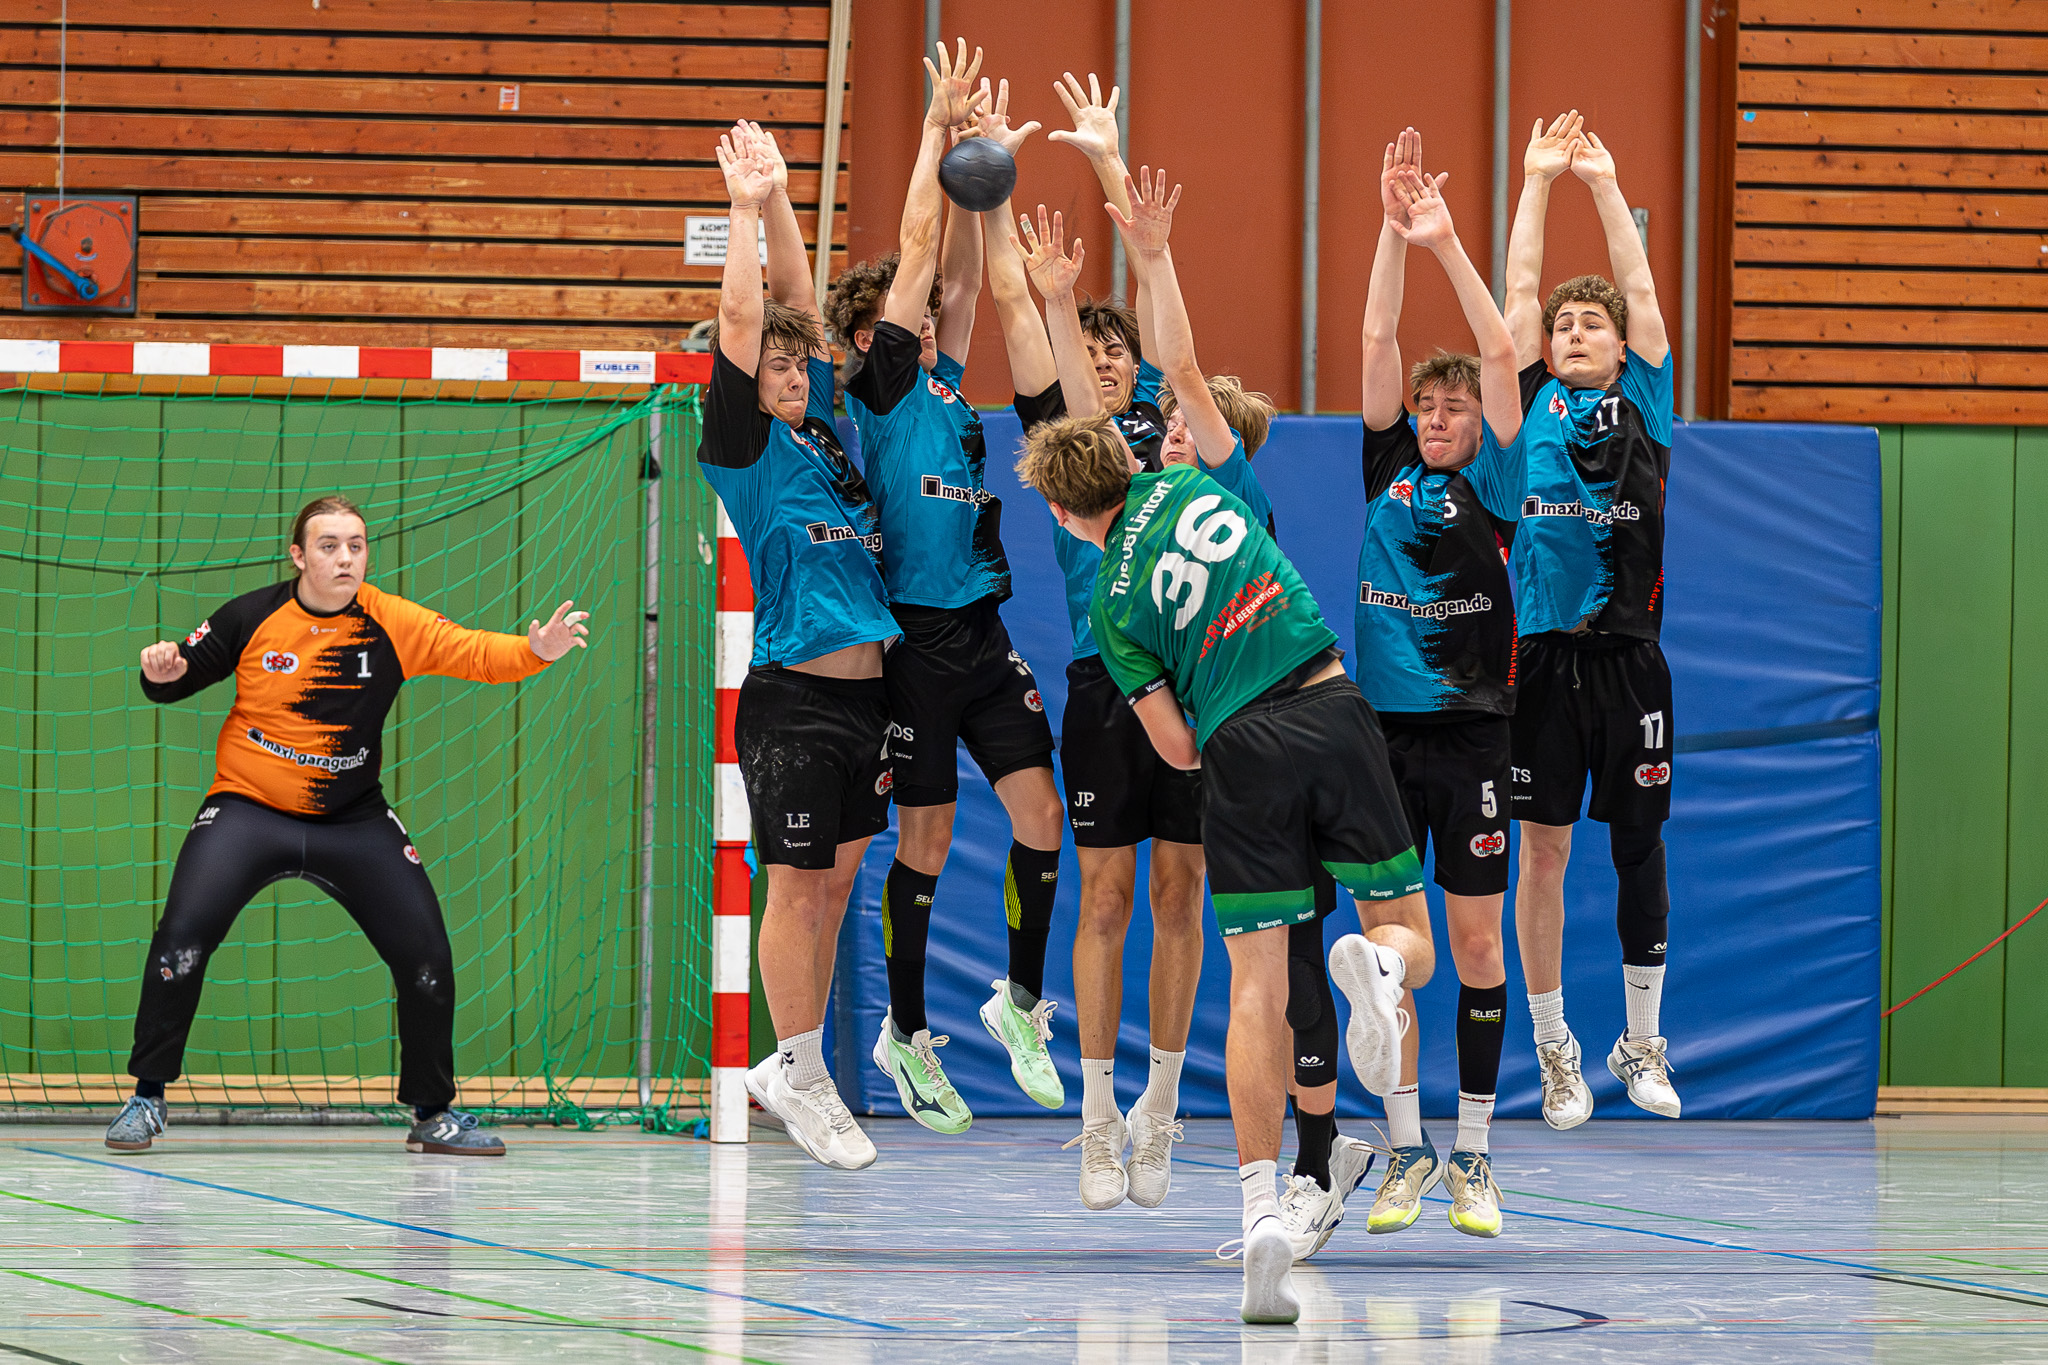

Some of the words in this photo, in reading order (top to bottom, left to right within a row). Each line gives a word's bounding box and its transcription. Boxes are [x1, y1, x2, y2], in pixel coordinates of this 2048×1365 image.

[1596, 396, 1620, 433] 17
[1151, 494, 1248, 631] 36
[357, 651, 372, 678] 1
[892, 722, 914, 741] DS
[1640, 710, 1664, 749] 17
[1510, 766, 1532, 783] TS
[1639, 767, 1668, 781] HSG
[1074, 791, 1096, 808] JP
[1481, 780, 1498, 818] 5
[785, 813, 811, 828] LE
[1475, 835, 1503, 851] HSG
[1256, 918, 1283, 930] Kempa
[1470, 1008, 1502, 1018] SELECT
